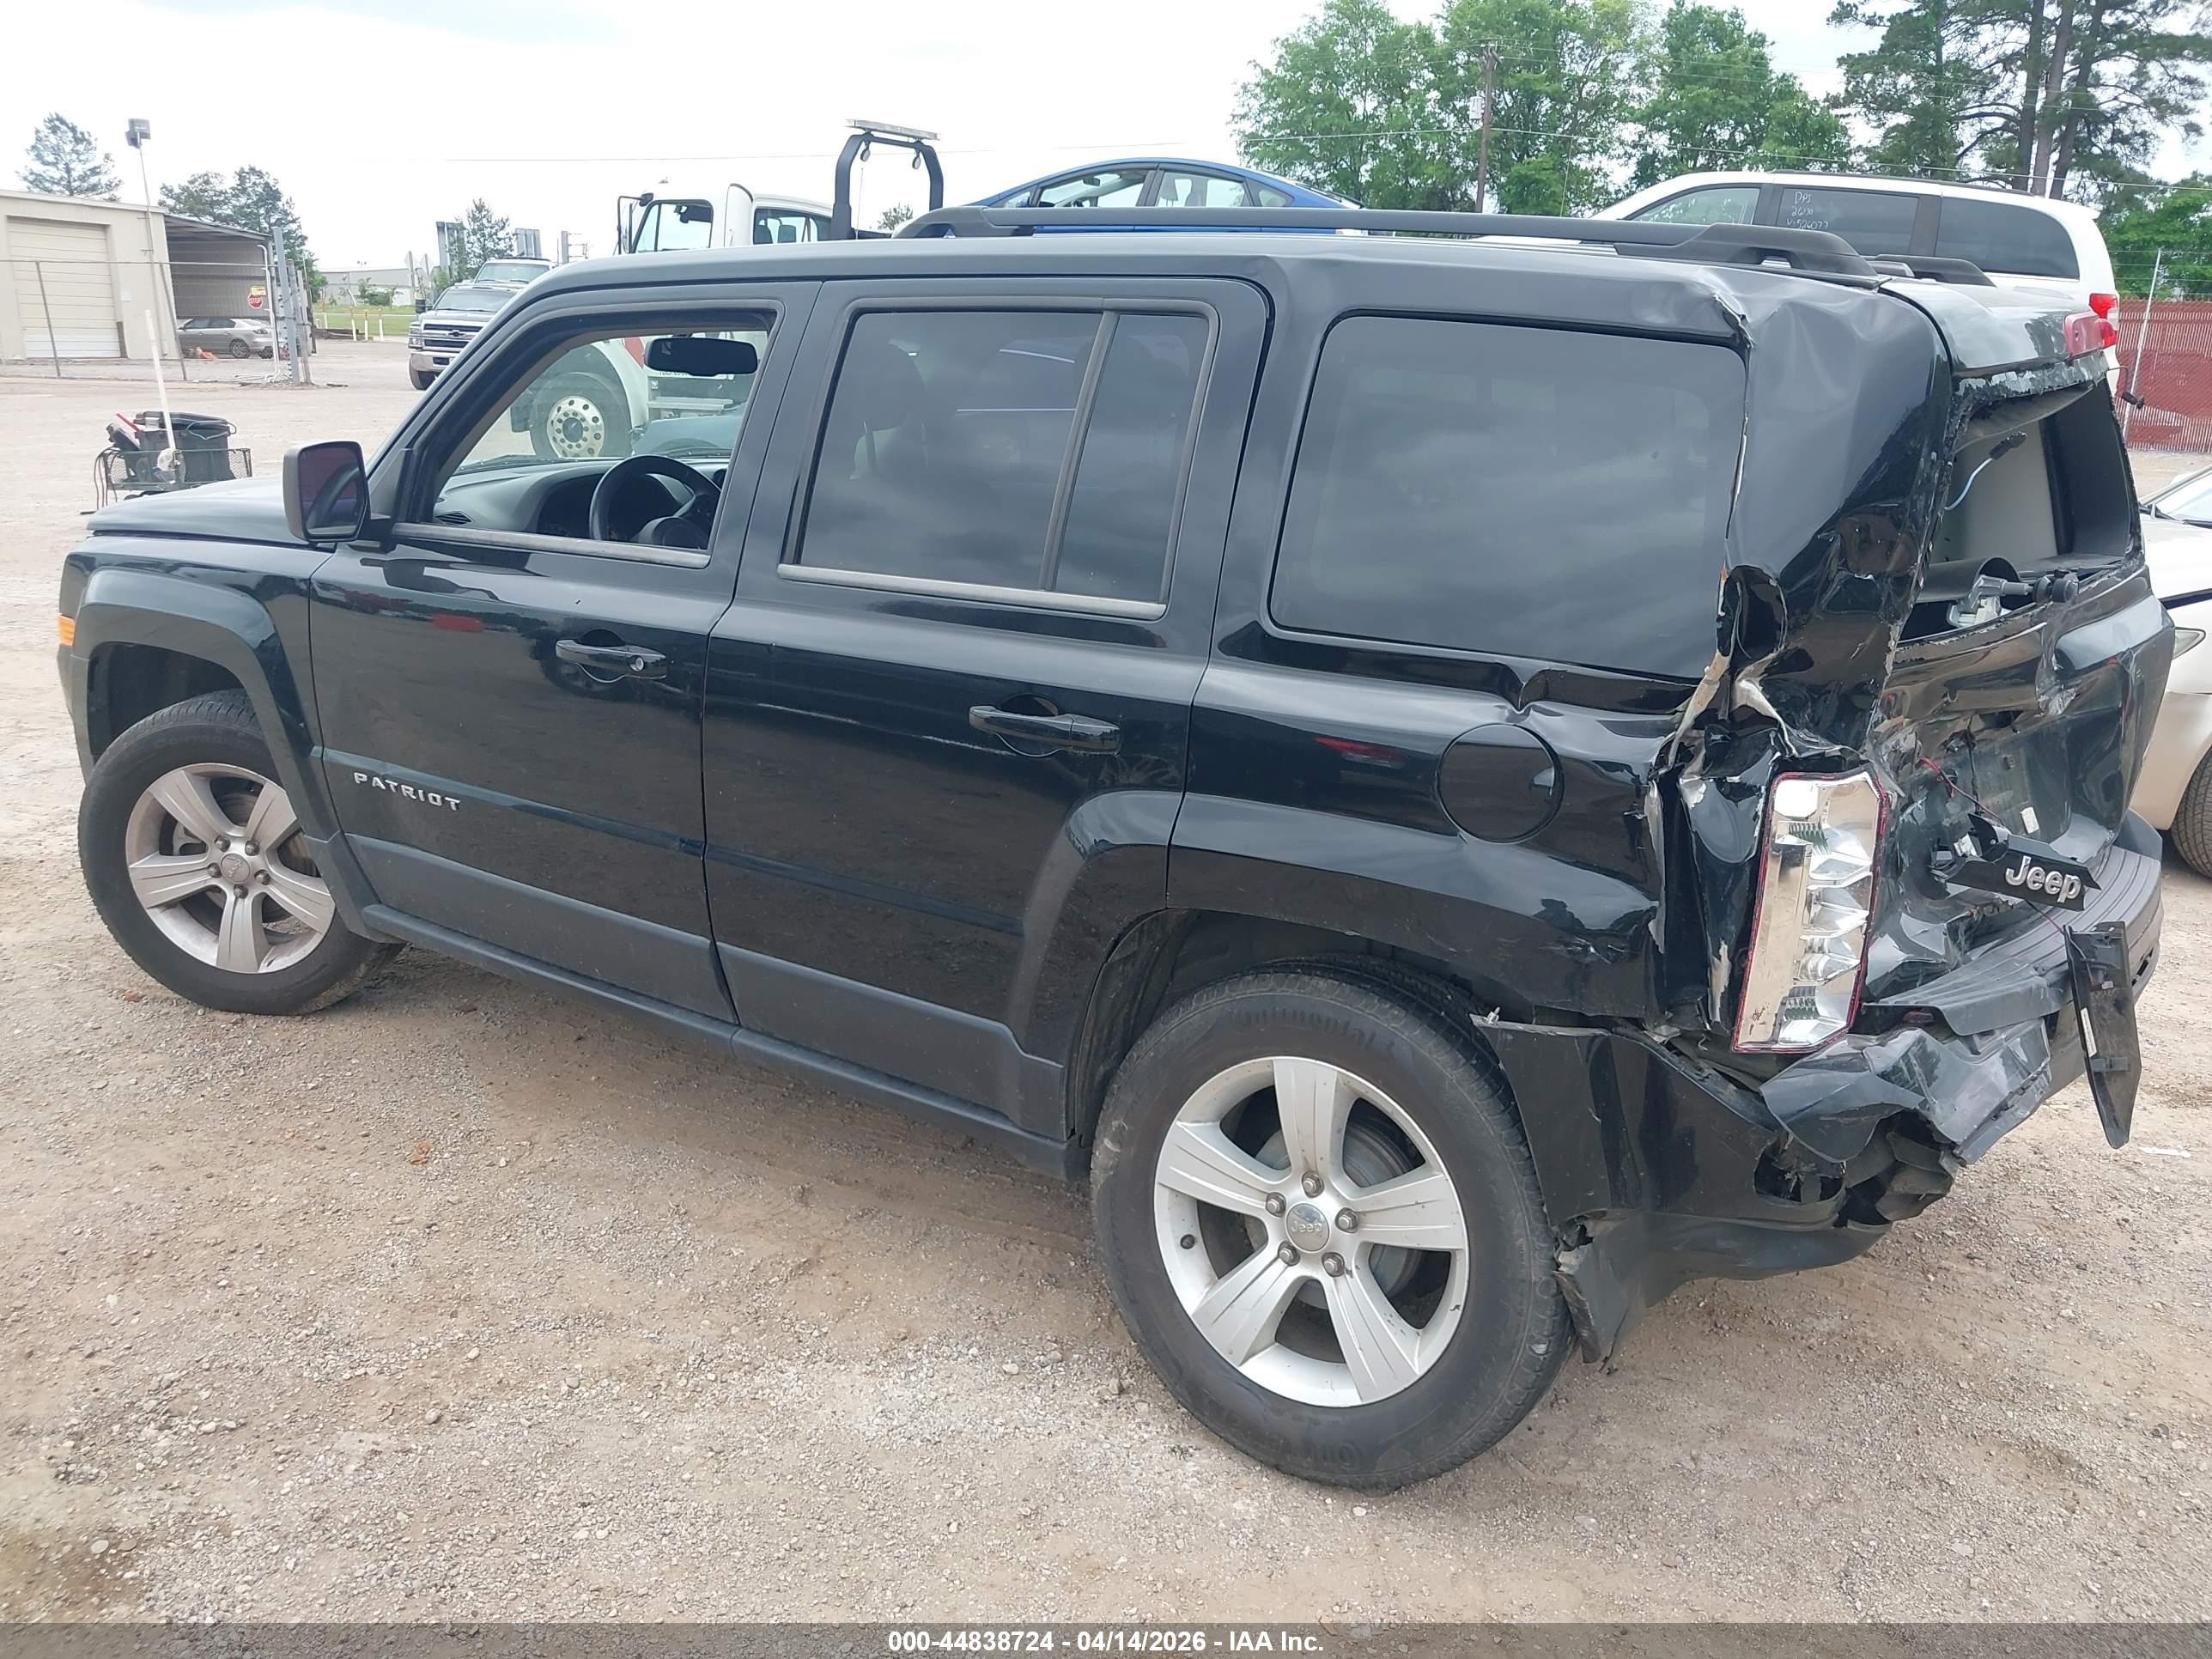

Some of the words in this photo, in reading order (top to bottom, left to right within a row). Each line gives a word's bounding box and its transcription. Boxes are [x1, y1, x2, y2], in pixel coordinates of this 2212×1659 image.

[1795, 191, 1812, 204] DPS
[353, 771, 461, 811] PATRIOT
[2005, 855, 2081, 902] Jeep
[1290, 1219, 1322, 1237] Jeep
